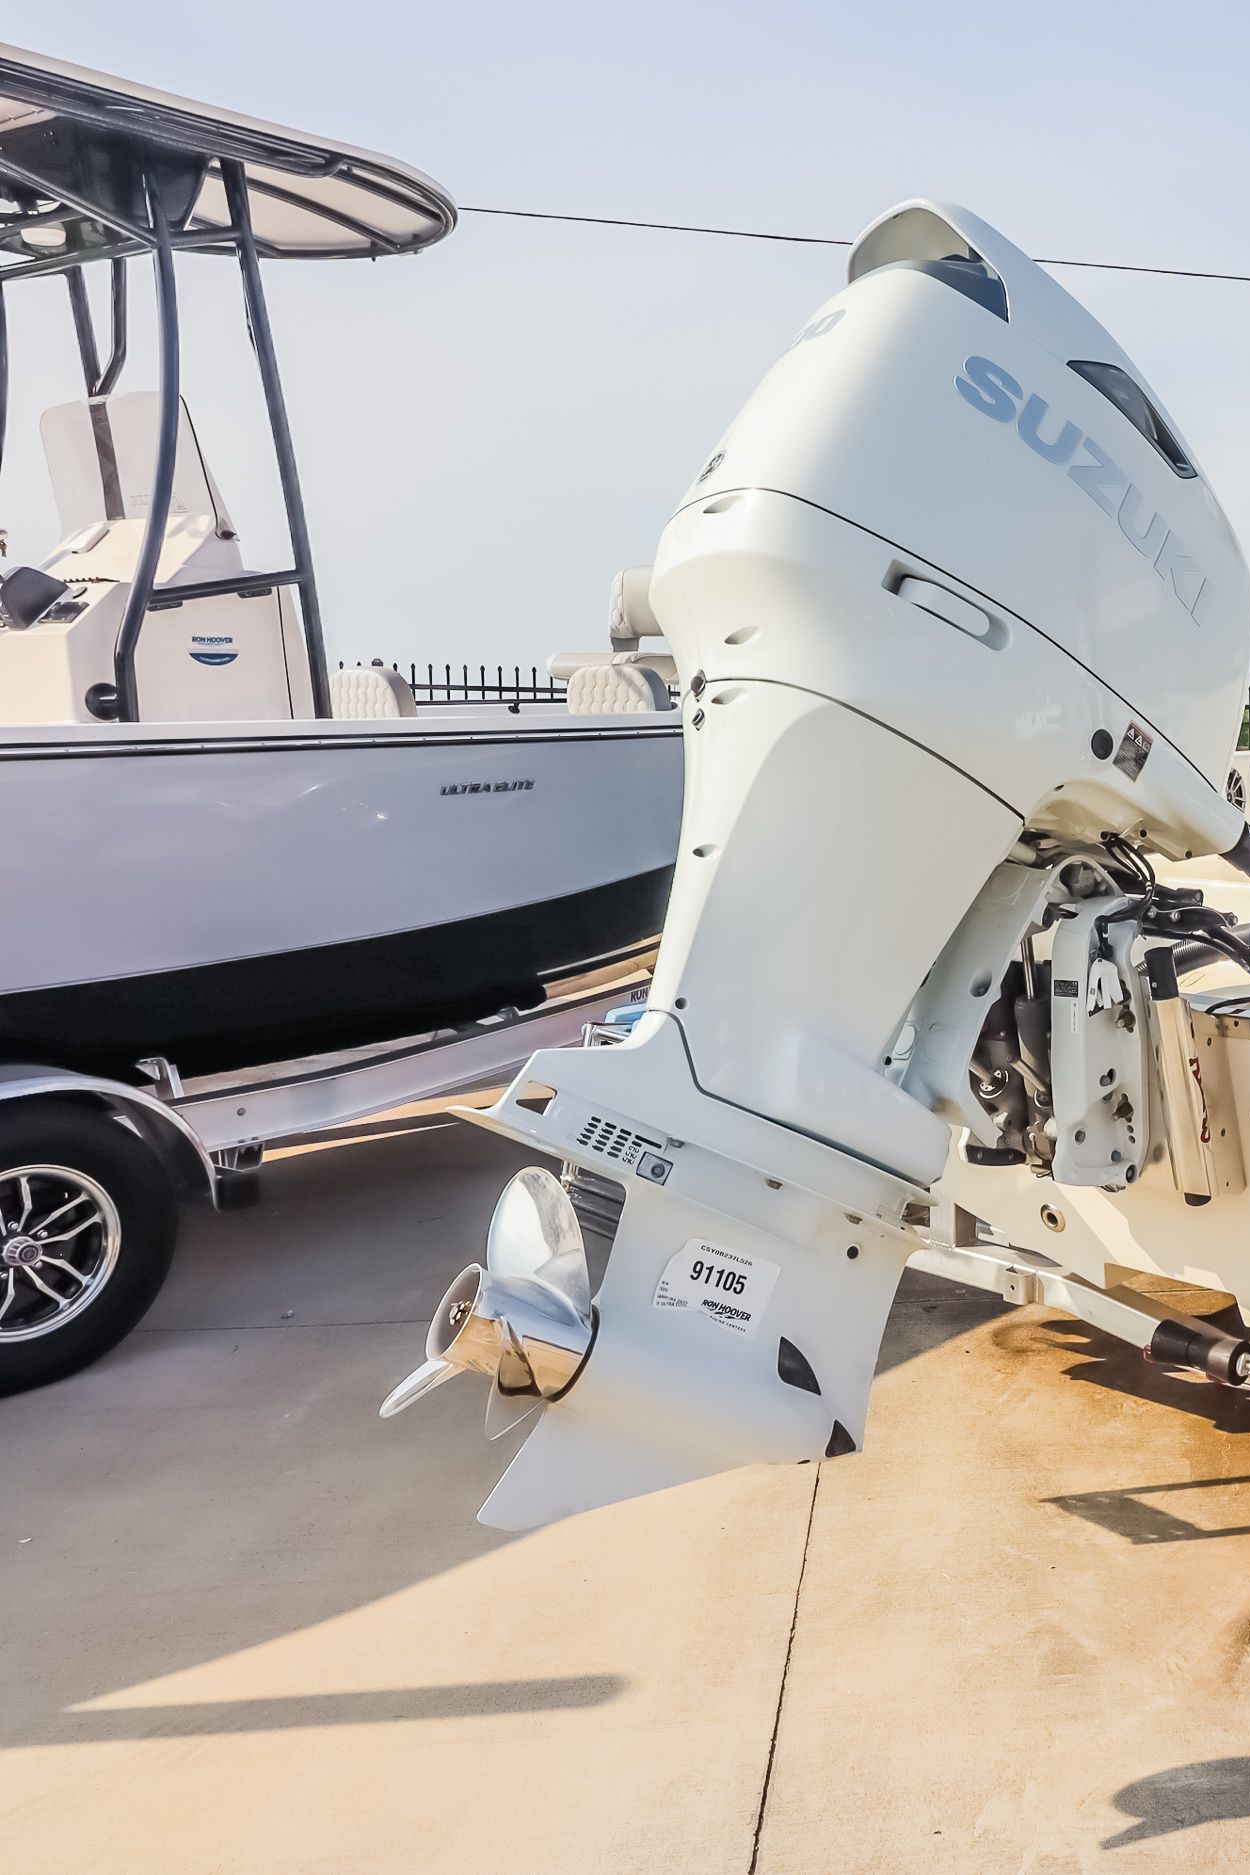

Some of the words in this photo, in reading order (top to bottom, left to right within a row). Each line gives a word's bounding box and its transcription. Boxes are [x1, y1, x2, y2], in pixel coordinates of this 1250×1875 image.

[953, 355, 1215, 627] SUZUKI
[206, 636, 233, 644] HOOVER
[440, 783, 491, 796] ULTRA
[492, 779, 536, 793] ELITE
[689, 1260, 748, 1295] 91105
[701, 1299, 720, 1311] RON
[719, 1303, 752, 1322] HOOVER
